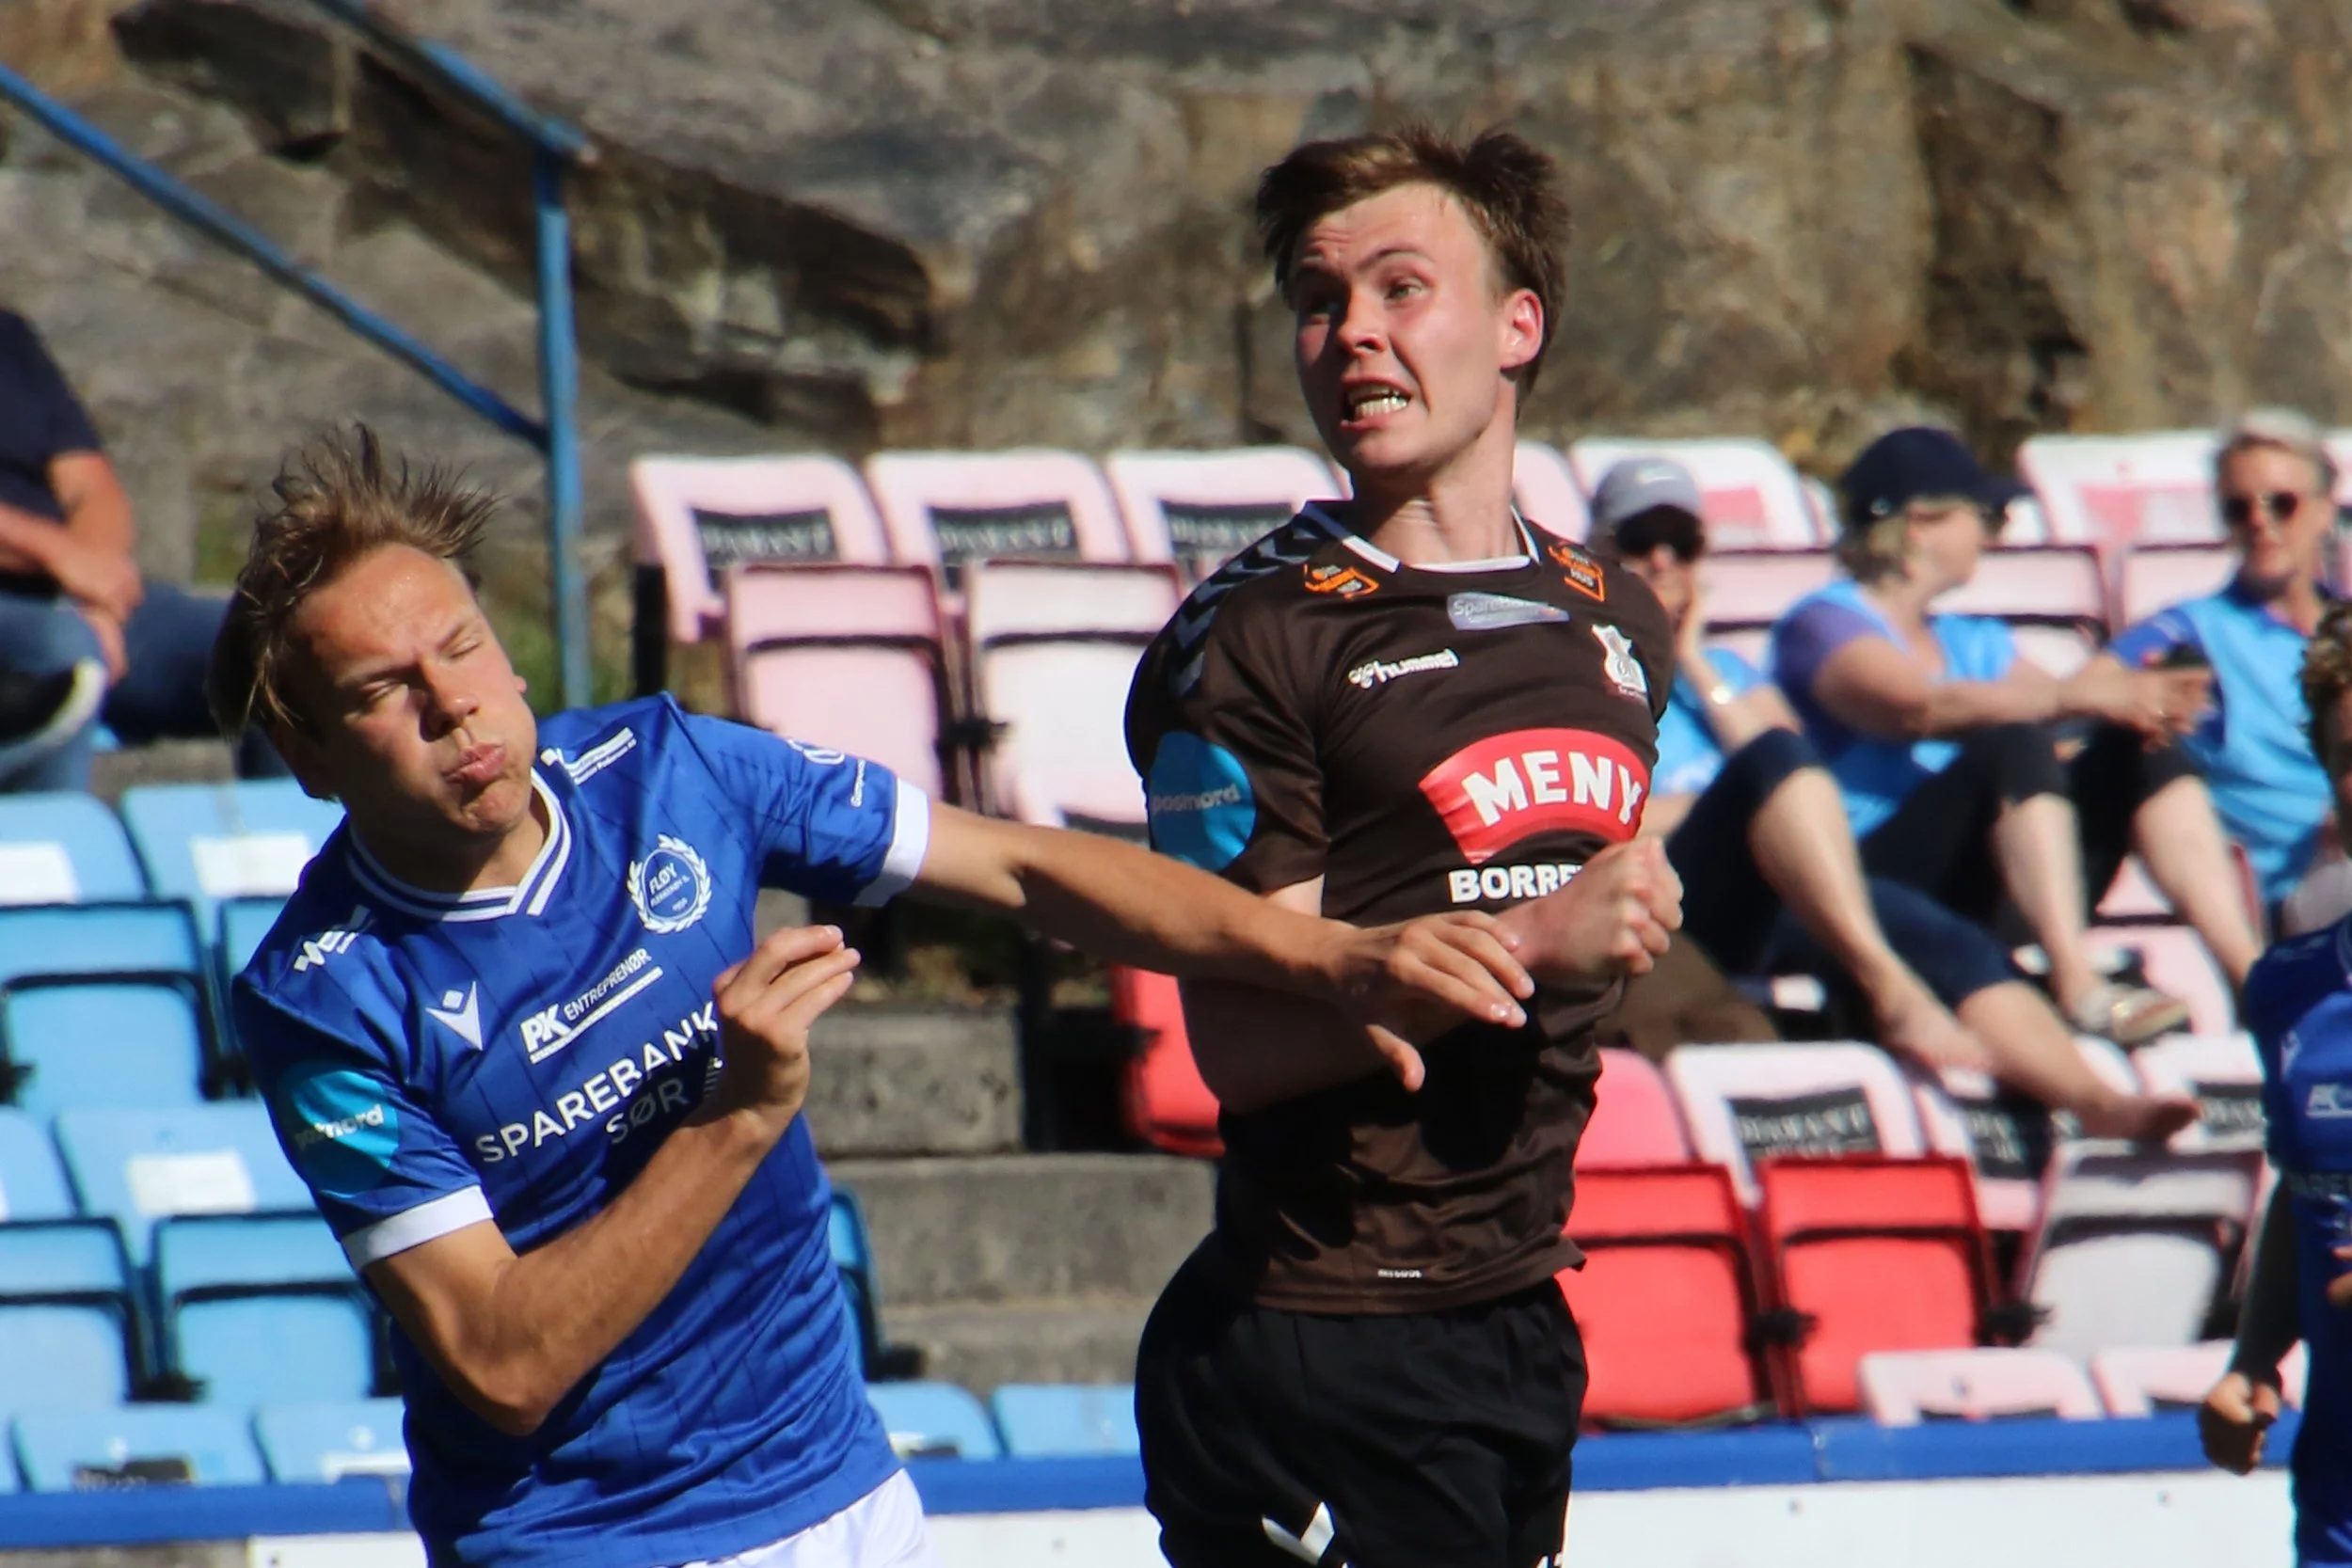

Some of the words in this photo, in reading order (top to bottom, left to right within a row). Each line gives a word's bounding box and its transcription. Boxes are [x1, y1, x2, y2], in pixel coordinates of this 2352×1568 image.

[1373, 648, 1459, 684] hummel
[1461, 751, 1643, 828] MENY
[1448, 863, 1583, 904] BORRE
[520, 1003, 572, 1053] PK
[564, 947, 653, 1022] ENTREPRENØR
[476, 1001, 719, 1163] SPAREBANK
[605, 1077, 690, 1146] SØR
